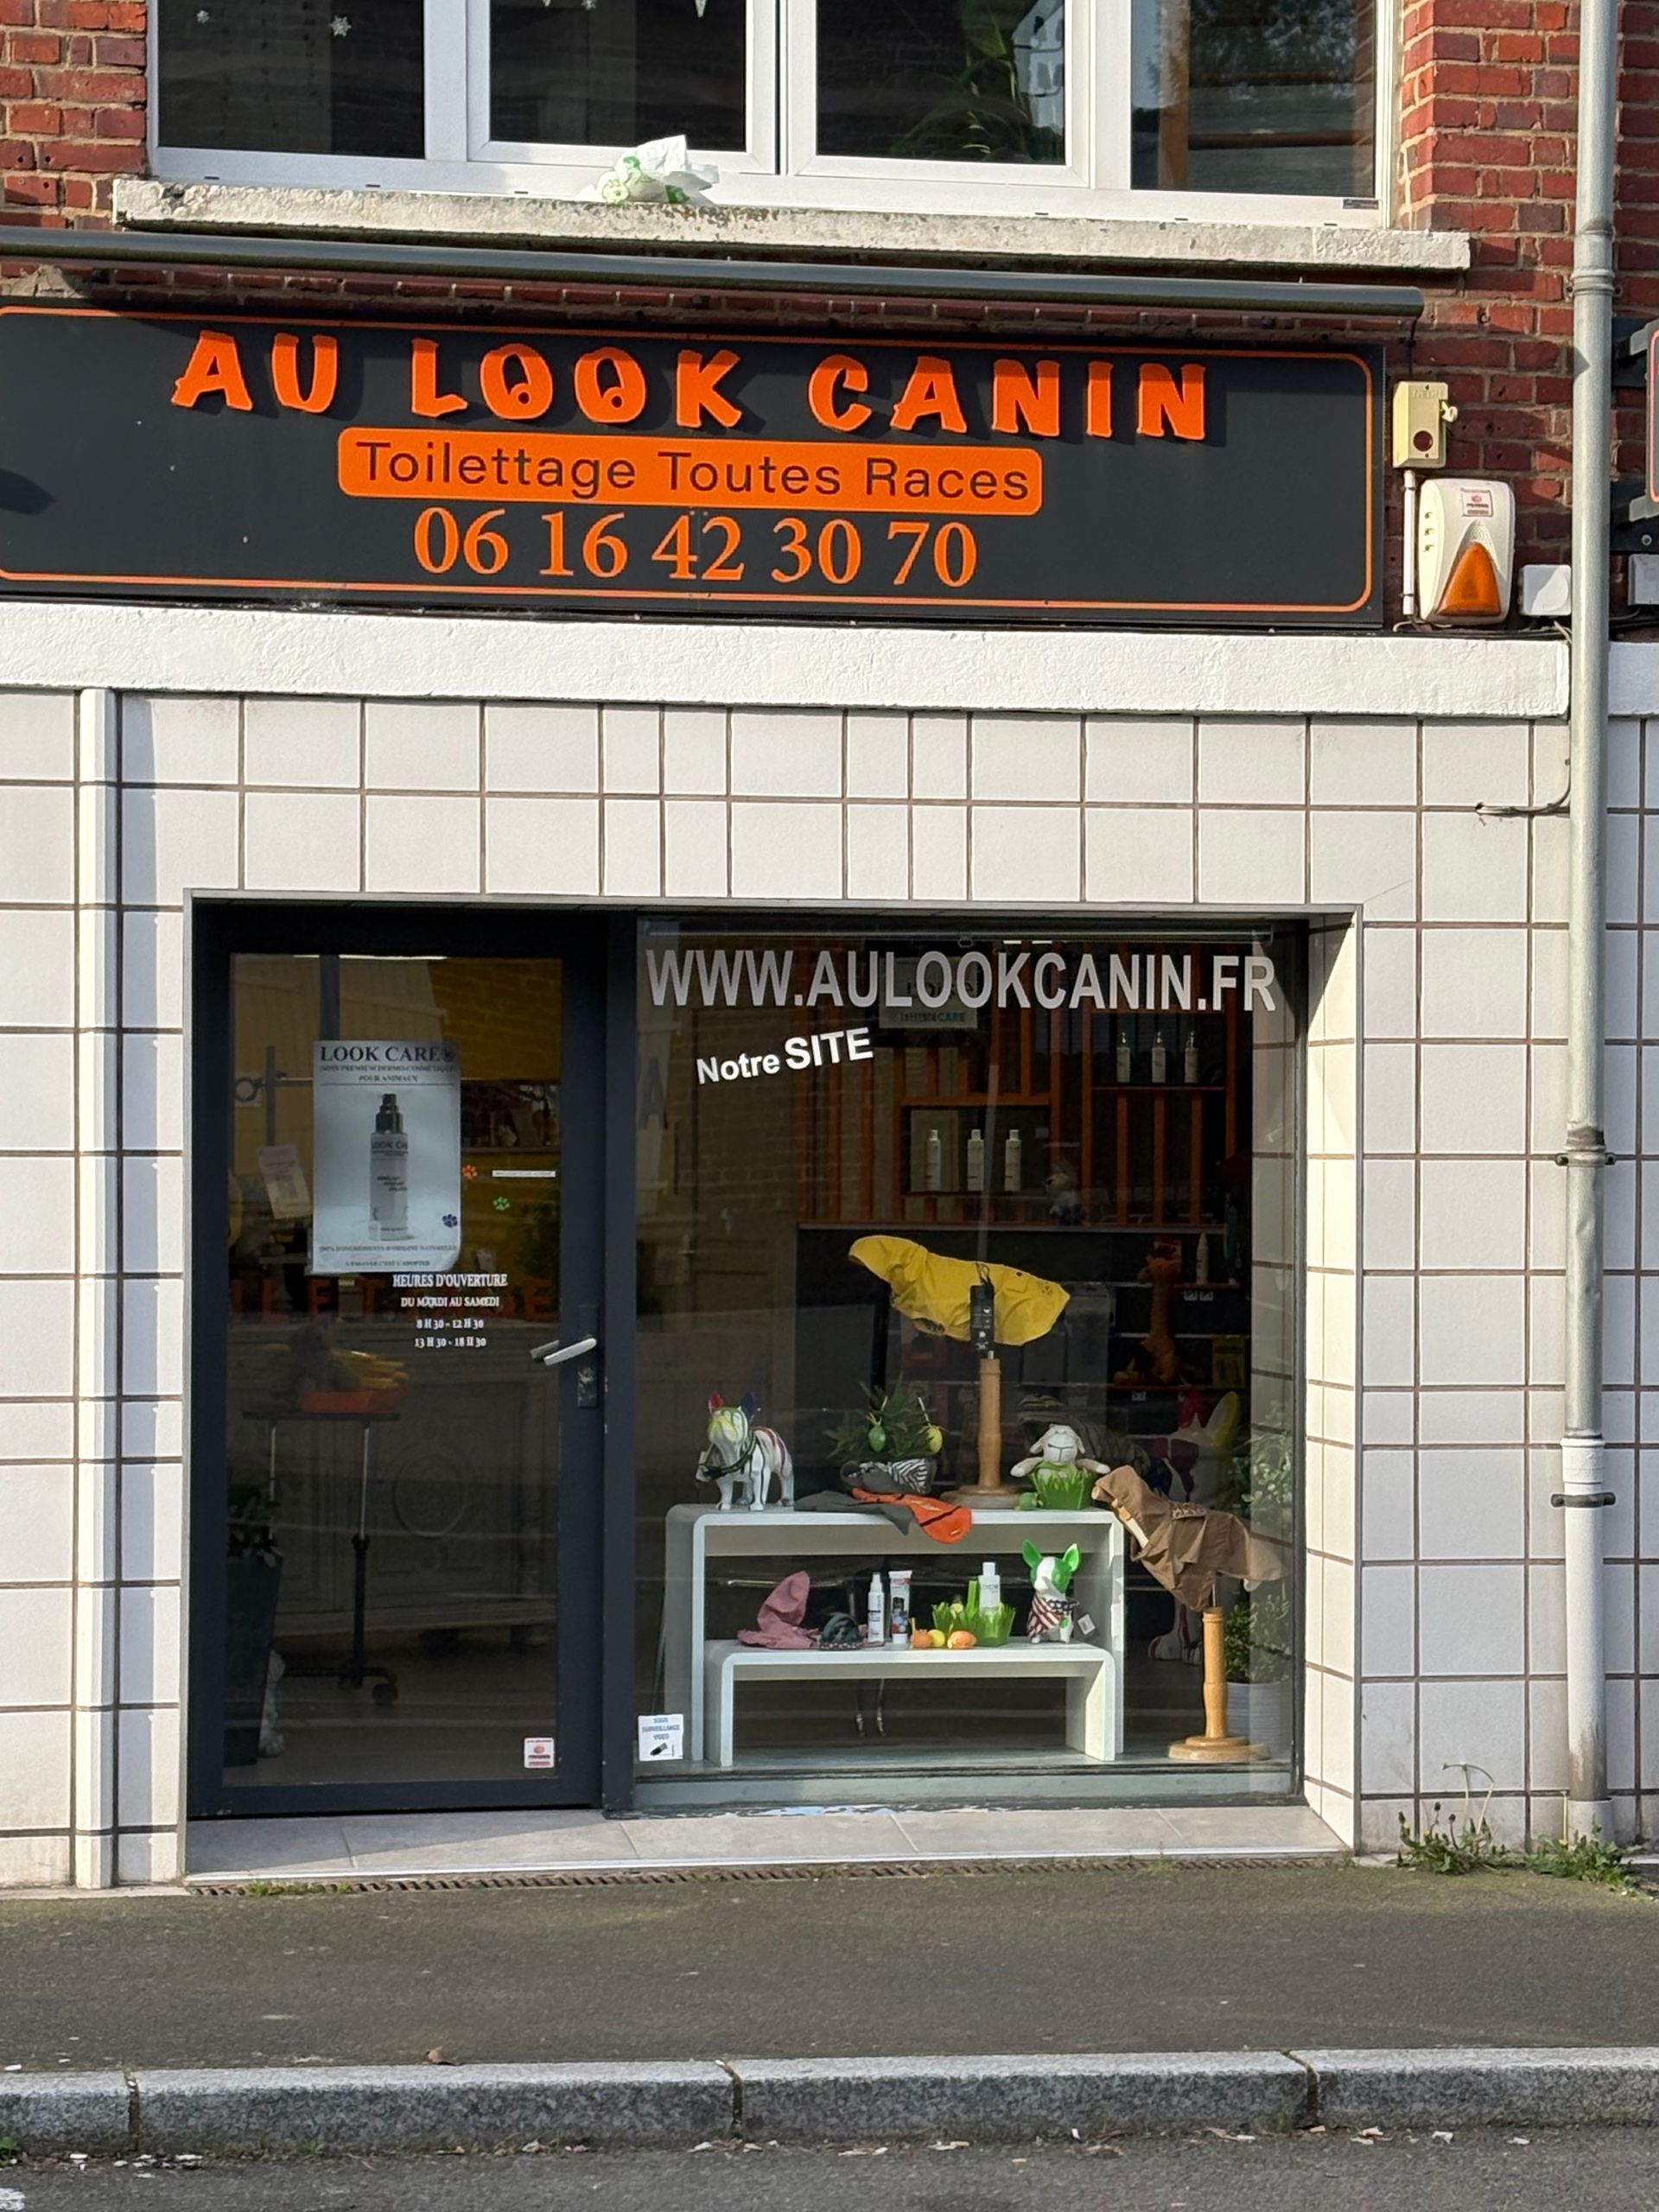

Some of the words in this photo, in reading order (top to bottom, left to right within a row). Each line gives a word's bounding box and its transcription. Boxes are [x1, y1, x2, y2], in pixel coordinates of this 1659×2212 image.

[172, 331, 337, 413] AU
[411, 340, 742, 428] LOOK
[808, 355, 1206, 442] CANIN
[357, 442, 635, 499] Toilettage
[658, 452, 840, 496] Toutes
[867, 457, 1028, 499] Races
[415, 507, 509, 574] 06
[543, 511, 629, 578] 16
[652, 514, 745, 582] 42
[772, 518, 862, 585] 30
[888, 520, 977, 588] 70
[646, 949, 1277, 1012] WWW.AULOOKCANIN.FR
[321, 1046, 378, 1061] LOOK
[696, 1052, 780, 1084] Notre
[785, 1027, 874, 1071] SITE
[392, 1274, 434, 1287] HEURES
[435, 1273, 508, 1287] D'OUVERTURE
[400, 1297, 415, 1307] DU
[449, 1296, 462, 1306] AU
[464, 1296, 499, 1306] SAMEDI
